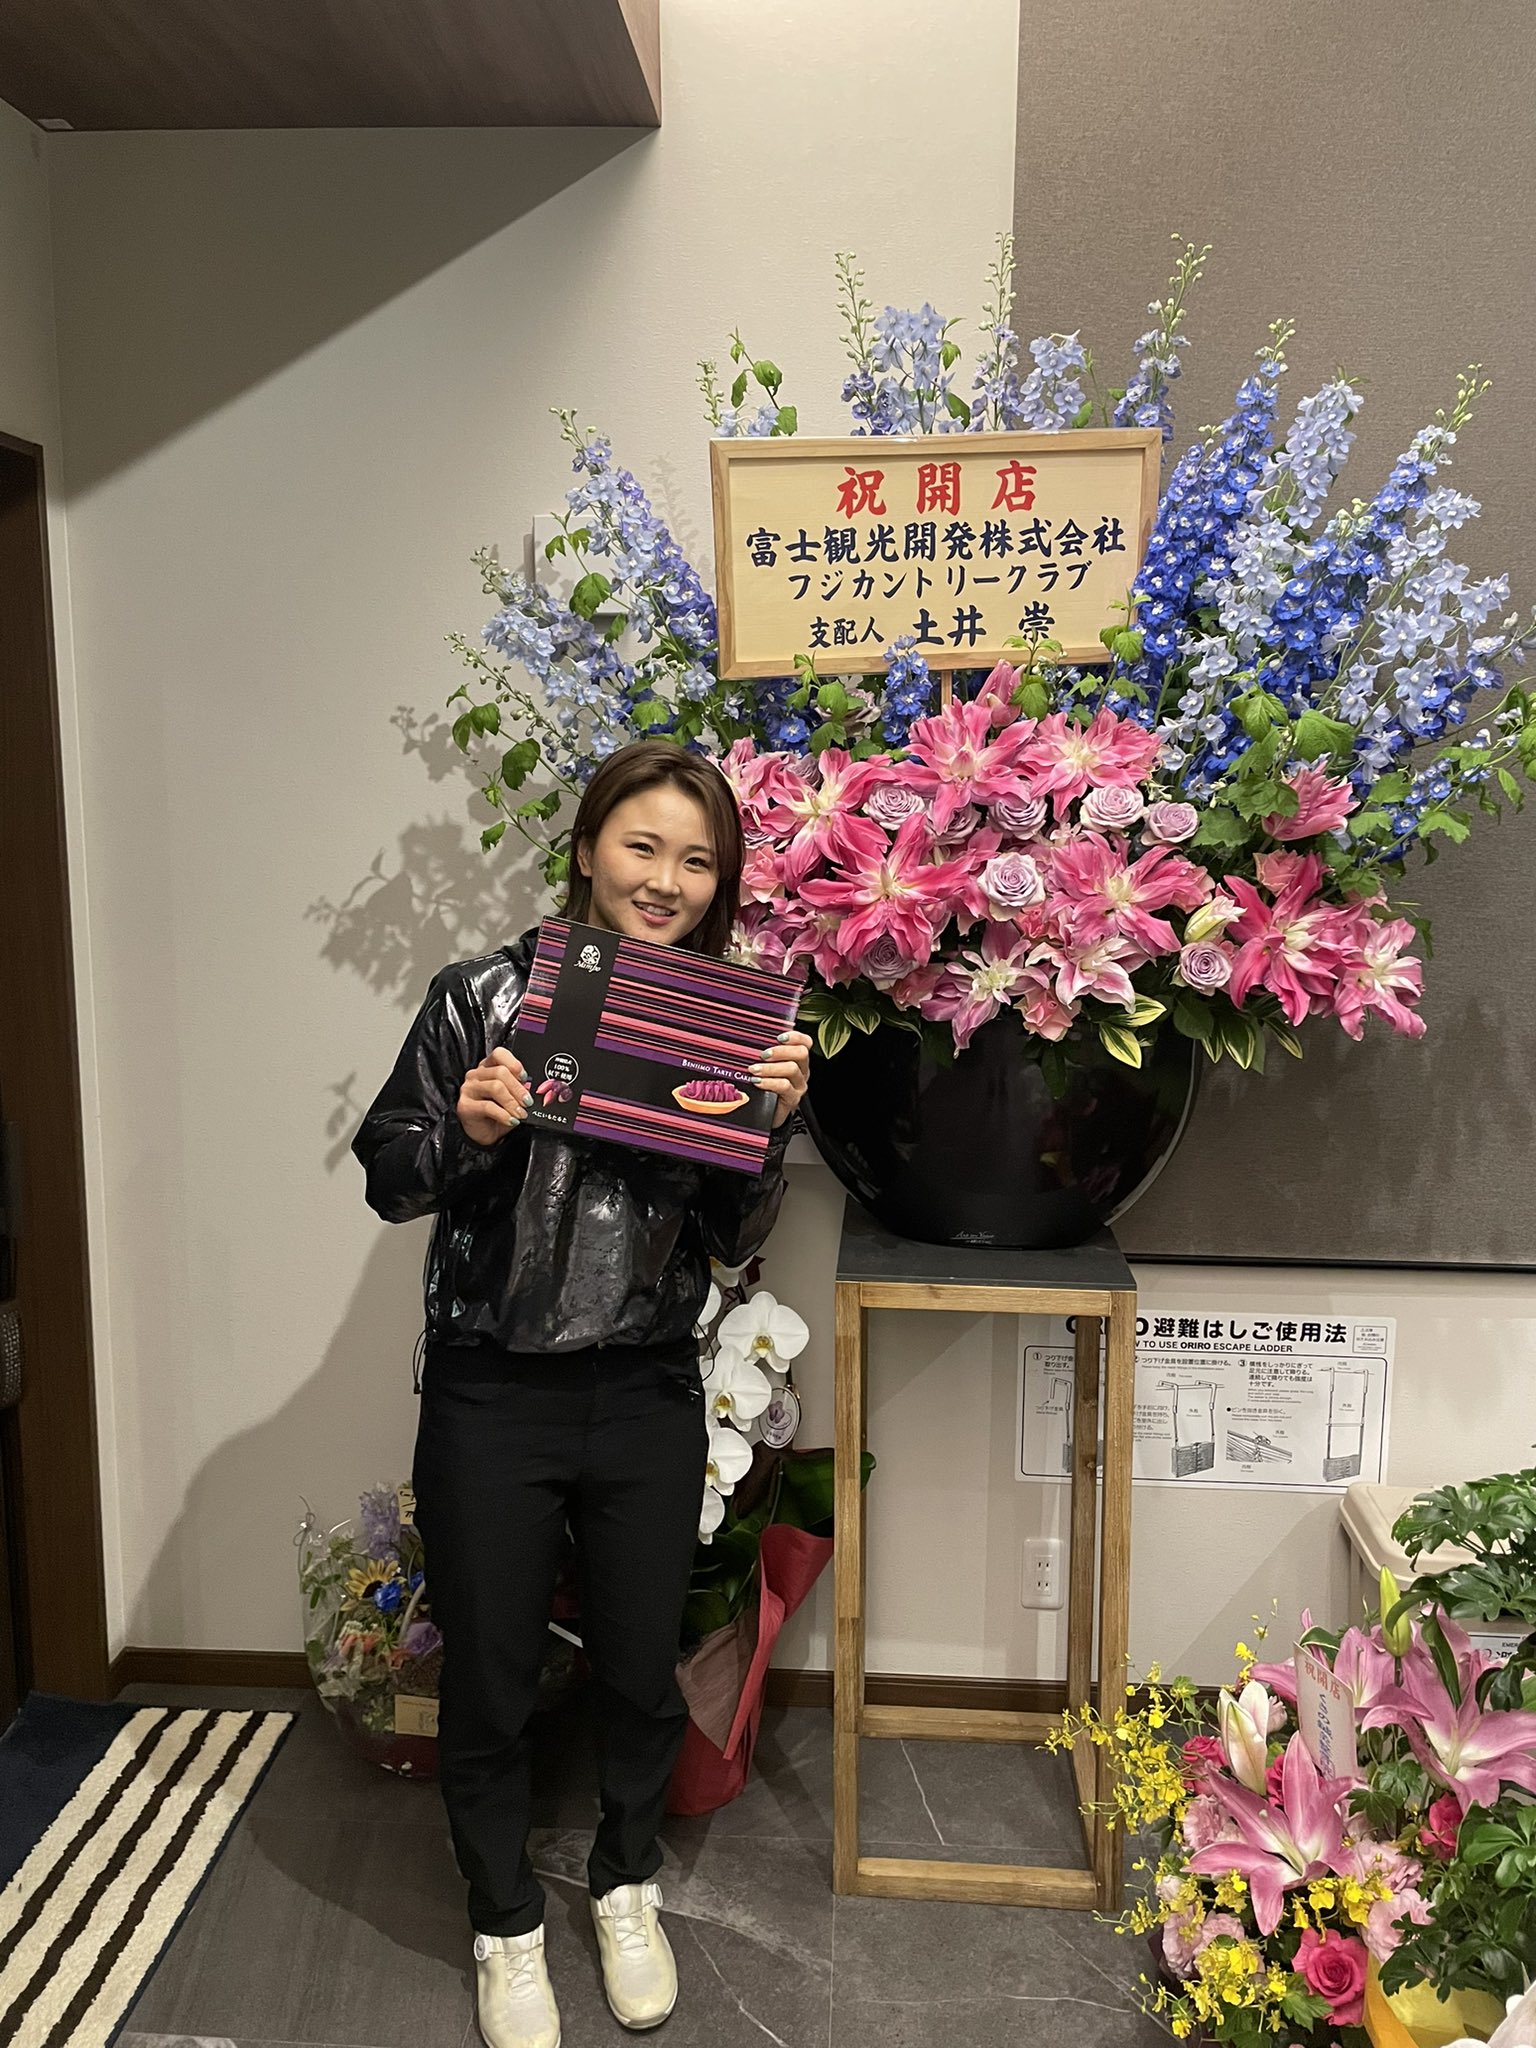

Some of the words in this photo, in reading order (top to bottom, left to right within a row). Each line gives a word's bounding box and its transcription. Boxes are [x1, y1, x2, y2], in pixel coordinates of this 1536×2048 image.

[745, 516, 1127, 569] 富士観光開発株式会社
[786, 560, 1093, 601] フジカントリークラブ
[808, 616, 885, 648] 支配人
[1142, 1340, 1156, 1348] TO
[1159, 1341, 1178, 1349] USE
[1180, 1341, 1211, 1350] ORIRO
[1214, 1343, 1251, 1351] ESCAPE
[1254, 1344, 1293, 1353] LADDER
